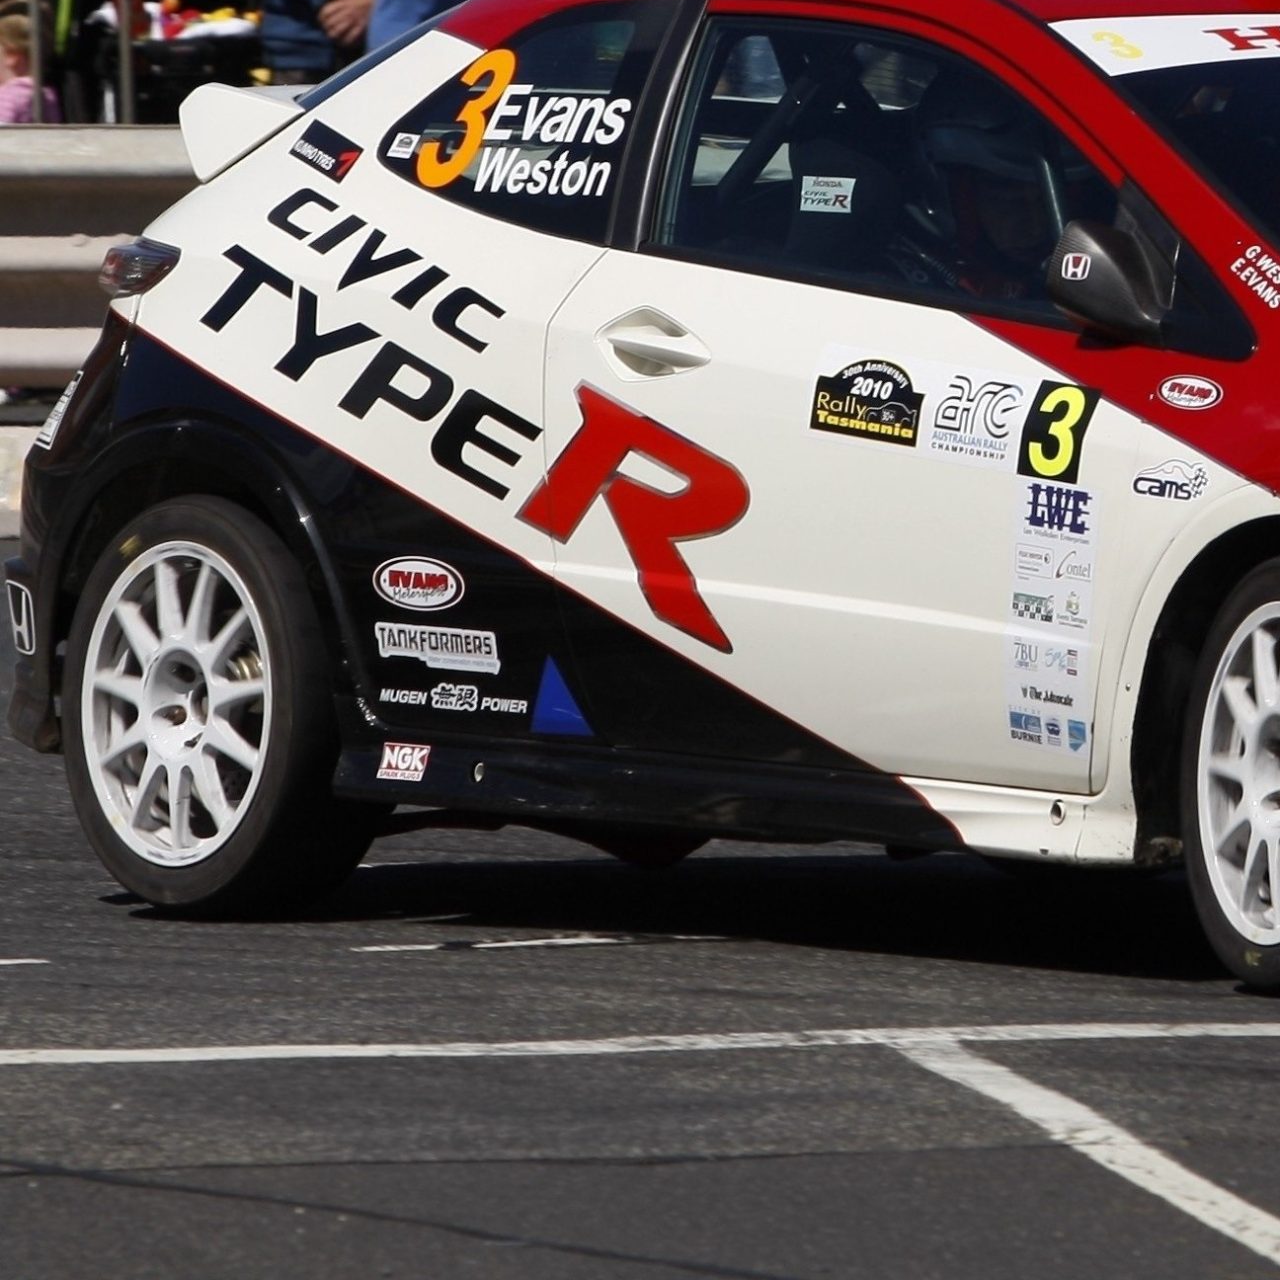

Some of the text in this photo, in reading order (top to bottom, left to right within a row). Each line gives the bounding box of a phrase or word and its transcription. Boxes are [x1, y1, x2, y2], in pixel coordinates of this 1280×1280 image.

[416, 48, 517, 189] 3
[482, 83, 632, 145] Evans
[473, 146, 612, 197] Weston
[267, 187, 507, 354] CIVIC
[842, 361, 910, 389] 30th Anniversary
[850, 376, 894, 401] 2010
[816, 391, 867, 420] Rally
[816, 409, 914, 439] Tasmania
[1027, 386, 1086, 477] 3
[198, 243, 751, 655] TYPE R
[930, 441, 1006, 460] CHAMPIONSHIP
[931, 430, 1009, 452] AUSTRALIAN RALLY
[1025, 482, 1093, 534] LWE
[378, 626, 493, 656] TANKFORMERS
[378, 688, 428, 705] MUGEN
[480, 696, 529, 714] POWER
[1010, 729, 1043, 745] BURNIE
[381, 745, 429, 771] NGK
